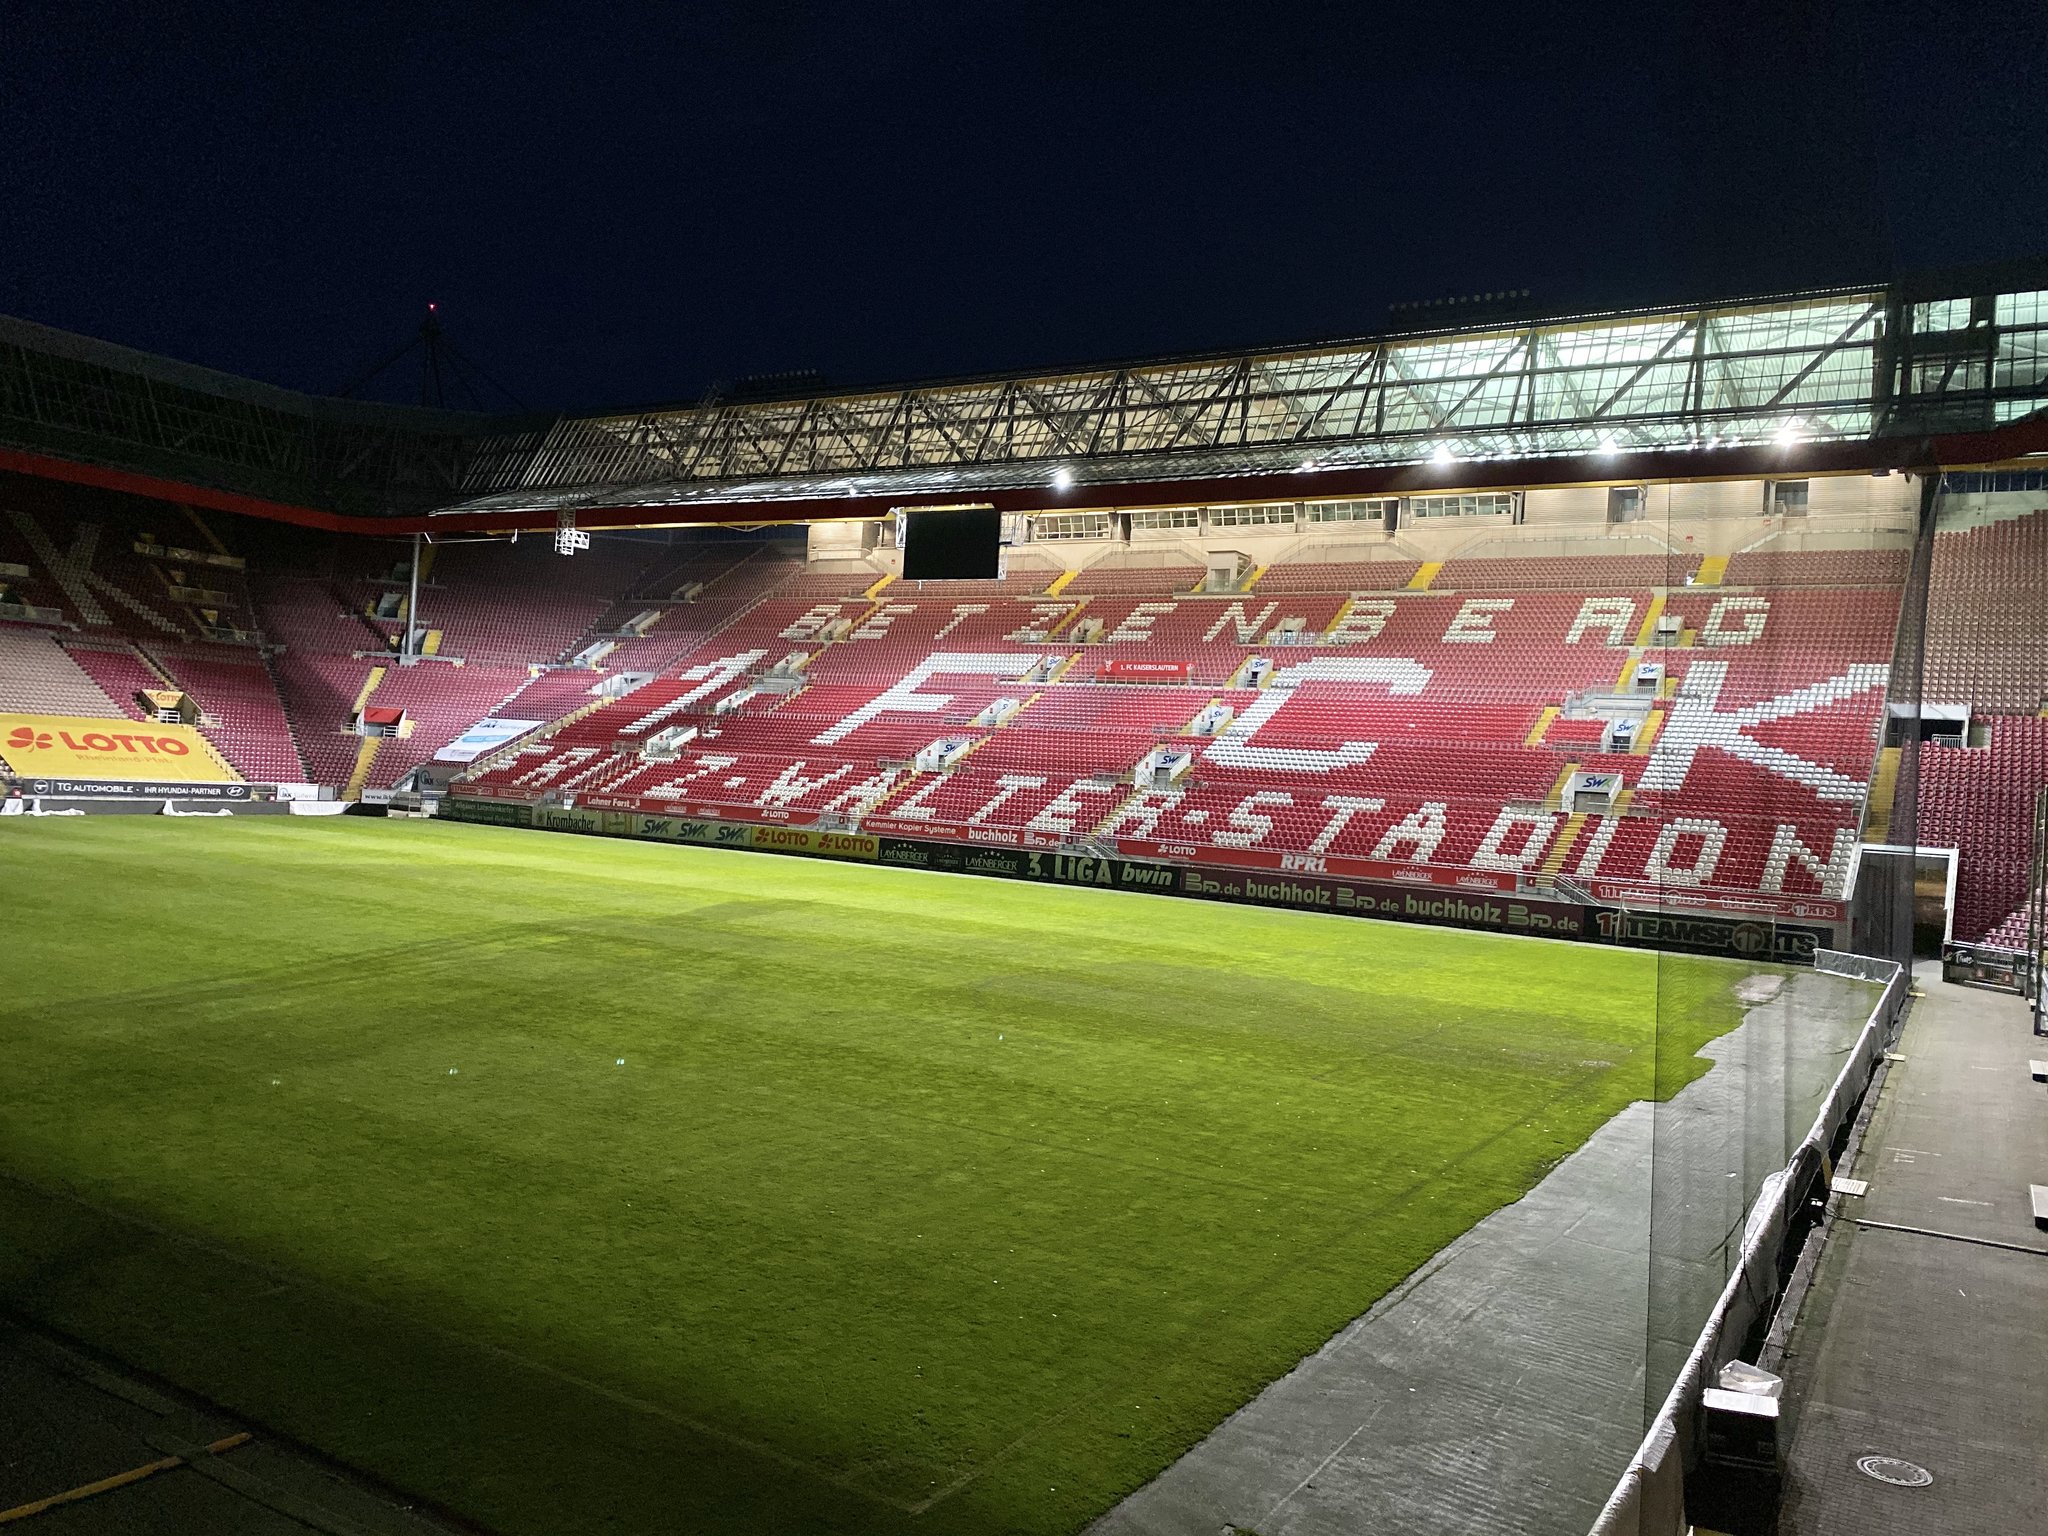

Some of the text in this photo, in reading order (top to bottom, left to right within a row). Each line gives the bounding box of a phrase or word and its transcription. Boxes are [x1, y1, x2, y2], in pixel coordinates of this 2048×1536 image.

[156, 692, 180, 702] LOTTO
[58, 731, 190, 756] LOTTO
[57, 782, 72, 791] TG
[73, 784, 134, 793] AUTOMOBILE
[144, 786, 157, 794] IHR
[158, 786, 221, 796] HYUNDAI-PARTNER
[545, 810, 596, 831] Krombacher
[769, 810, 790, 820] LOTTO
[641, 819, 673, 835] SWK
[677, 823, 709, 838] SWK
[715, 826, 750, 843] SWK
[865, 820, 957, 835] Kemmler Kopier Systeme
[771, 829, 809, 846] LOTTO
[835, 835, 875, 853] LOTTO
[967, 828, 1019, 844] buchholz
[879, 848, 929, 862] LAYENBERGER
[1168, 844, 1197, 856] LOTTO
[964, 858, 1018, 871] LAYENBERGER
[1026, 851, 1113, 884] 3. LIGA
[1280, 854, 1328, 873] RPR1.
[1120, 861, 1173, 886] bwin
[1391, 869, 1433, 880] LAYENBERGER
[1455, 875, 1499, 886] LAYENBERGER
[1246, 878, 1331, 905] buchholz
[1405, 893, 1502, 922] buchholz
